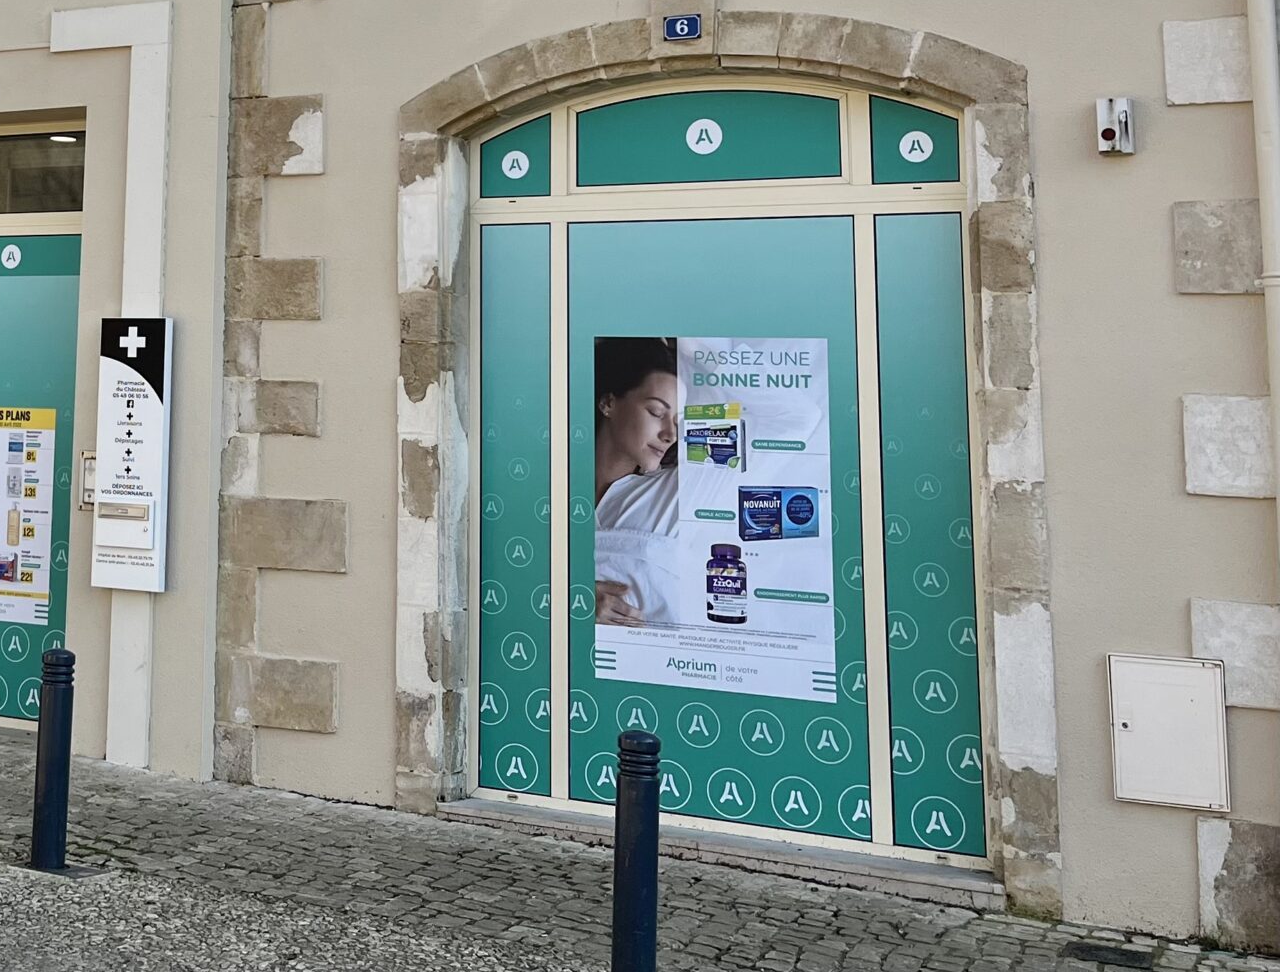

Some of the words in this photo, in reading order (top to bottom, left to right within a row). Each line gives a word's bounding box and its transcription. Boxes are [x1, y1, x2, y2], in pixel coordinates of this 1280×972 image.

[676, 20, 688, 35] 6
[693, 350, 764, 366] PASSEZ
[770, 351, 810, 367] UNE
[692, 373, 760, 388] BONNE
[766, 374, 813, 389] NUIT
[5, 410, 31, 421] PLANS
[705, 406, 721, 416] -2€
[115, 437, 144, 445] Dépistages
[744, 495, 781, 509] NOVANUIT
[713, 577, 741, 588] ZzzQuil
[666, 656, 716, 673] Aprium
[725, 665, 736, 673] de
[737, 666, 758, 675] votre
[681, 671, 716, 680] PHARMACIE
[725, 675, 743, 683] côté
